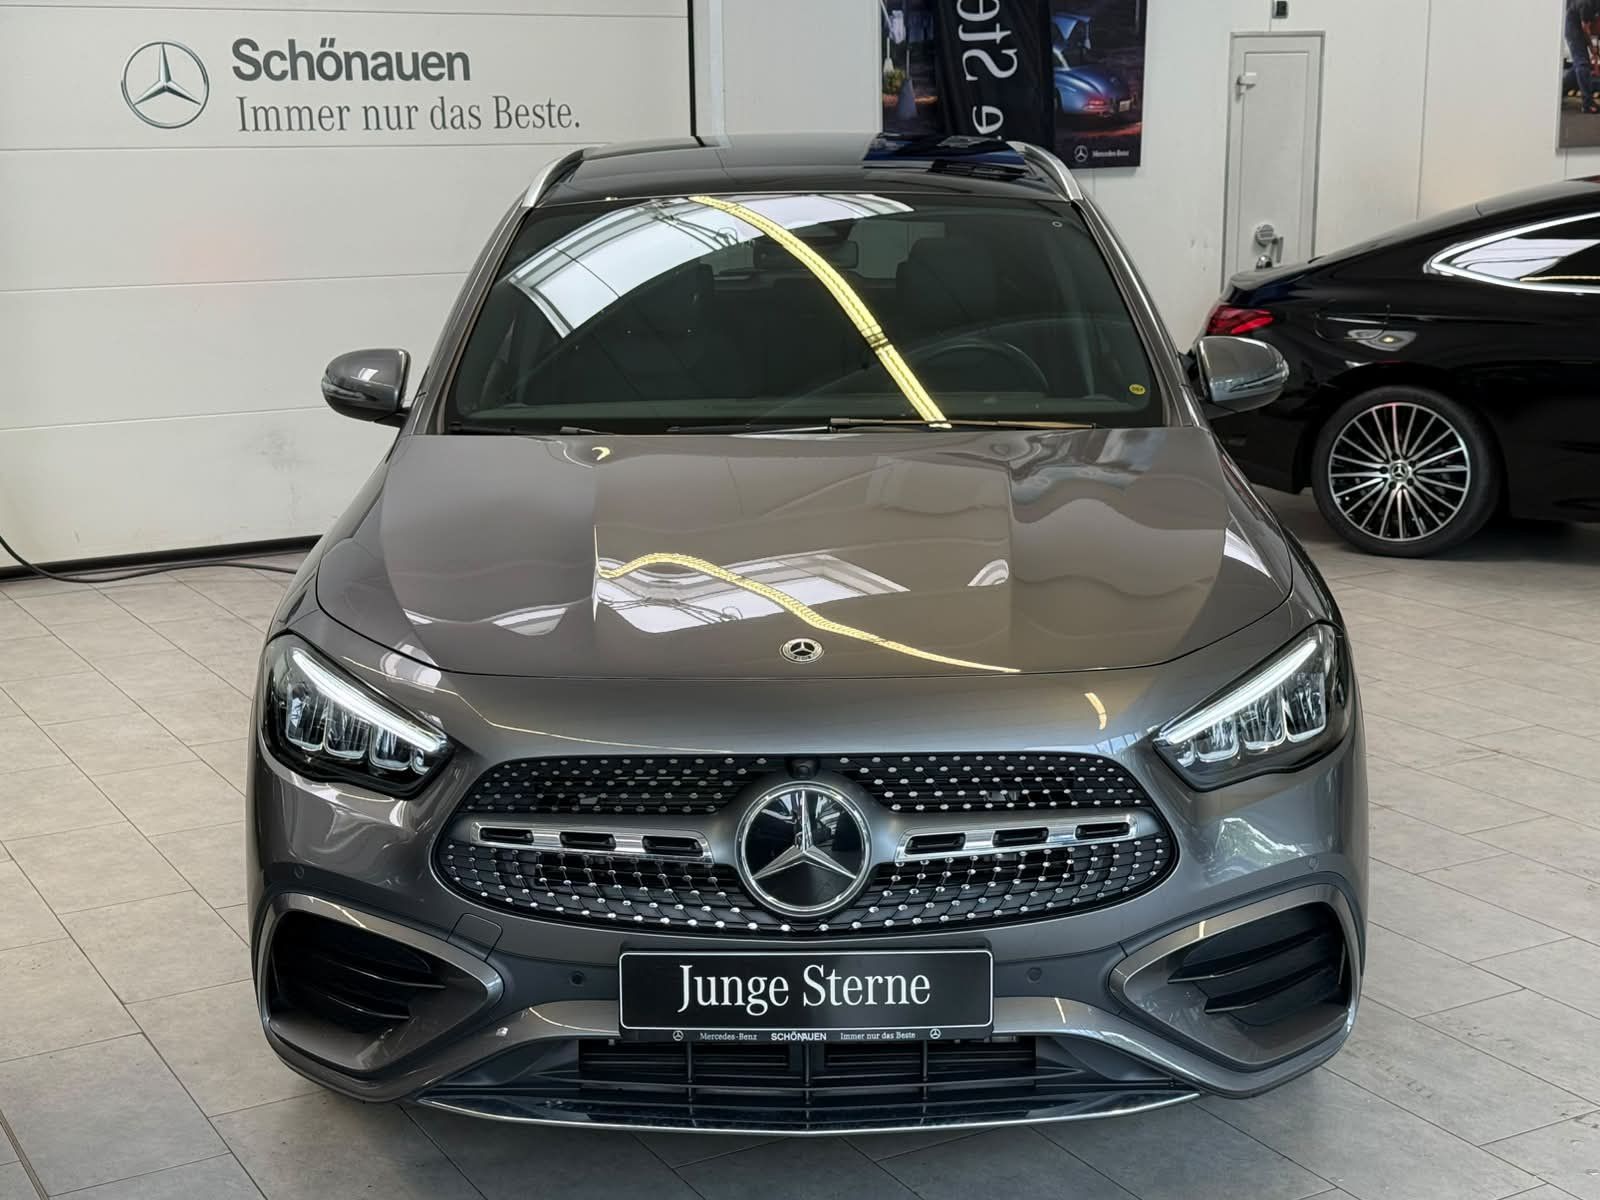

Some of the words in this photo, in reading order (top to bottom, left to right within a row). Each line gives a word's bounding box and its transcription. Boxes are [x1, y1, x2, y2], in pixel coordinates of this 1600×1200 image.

[231, 37, 471, 82] Schönauen
[236, 96, 351, 132] Immer
[362, 103, 419, 131] nur
[430, 95, 482, 131] das
[493, 95, 581, 130] Beste.
[677, 964, 789, 1017] Junge
[803, 964, 931, 1007] Sterne
[699, 1032, 758, 1041] Mercedes-Benz
[840, 1032, 864, 1040] Immer
[881, 1031, 894, 1040] das
[896, 1031, 916, 1039] Beste
